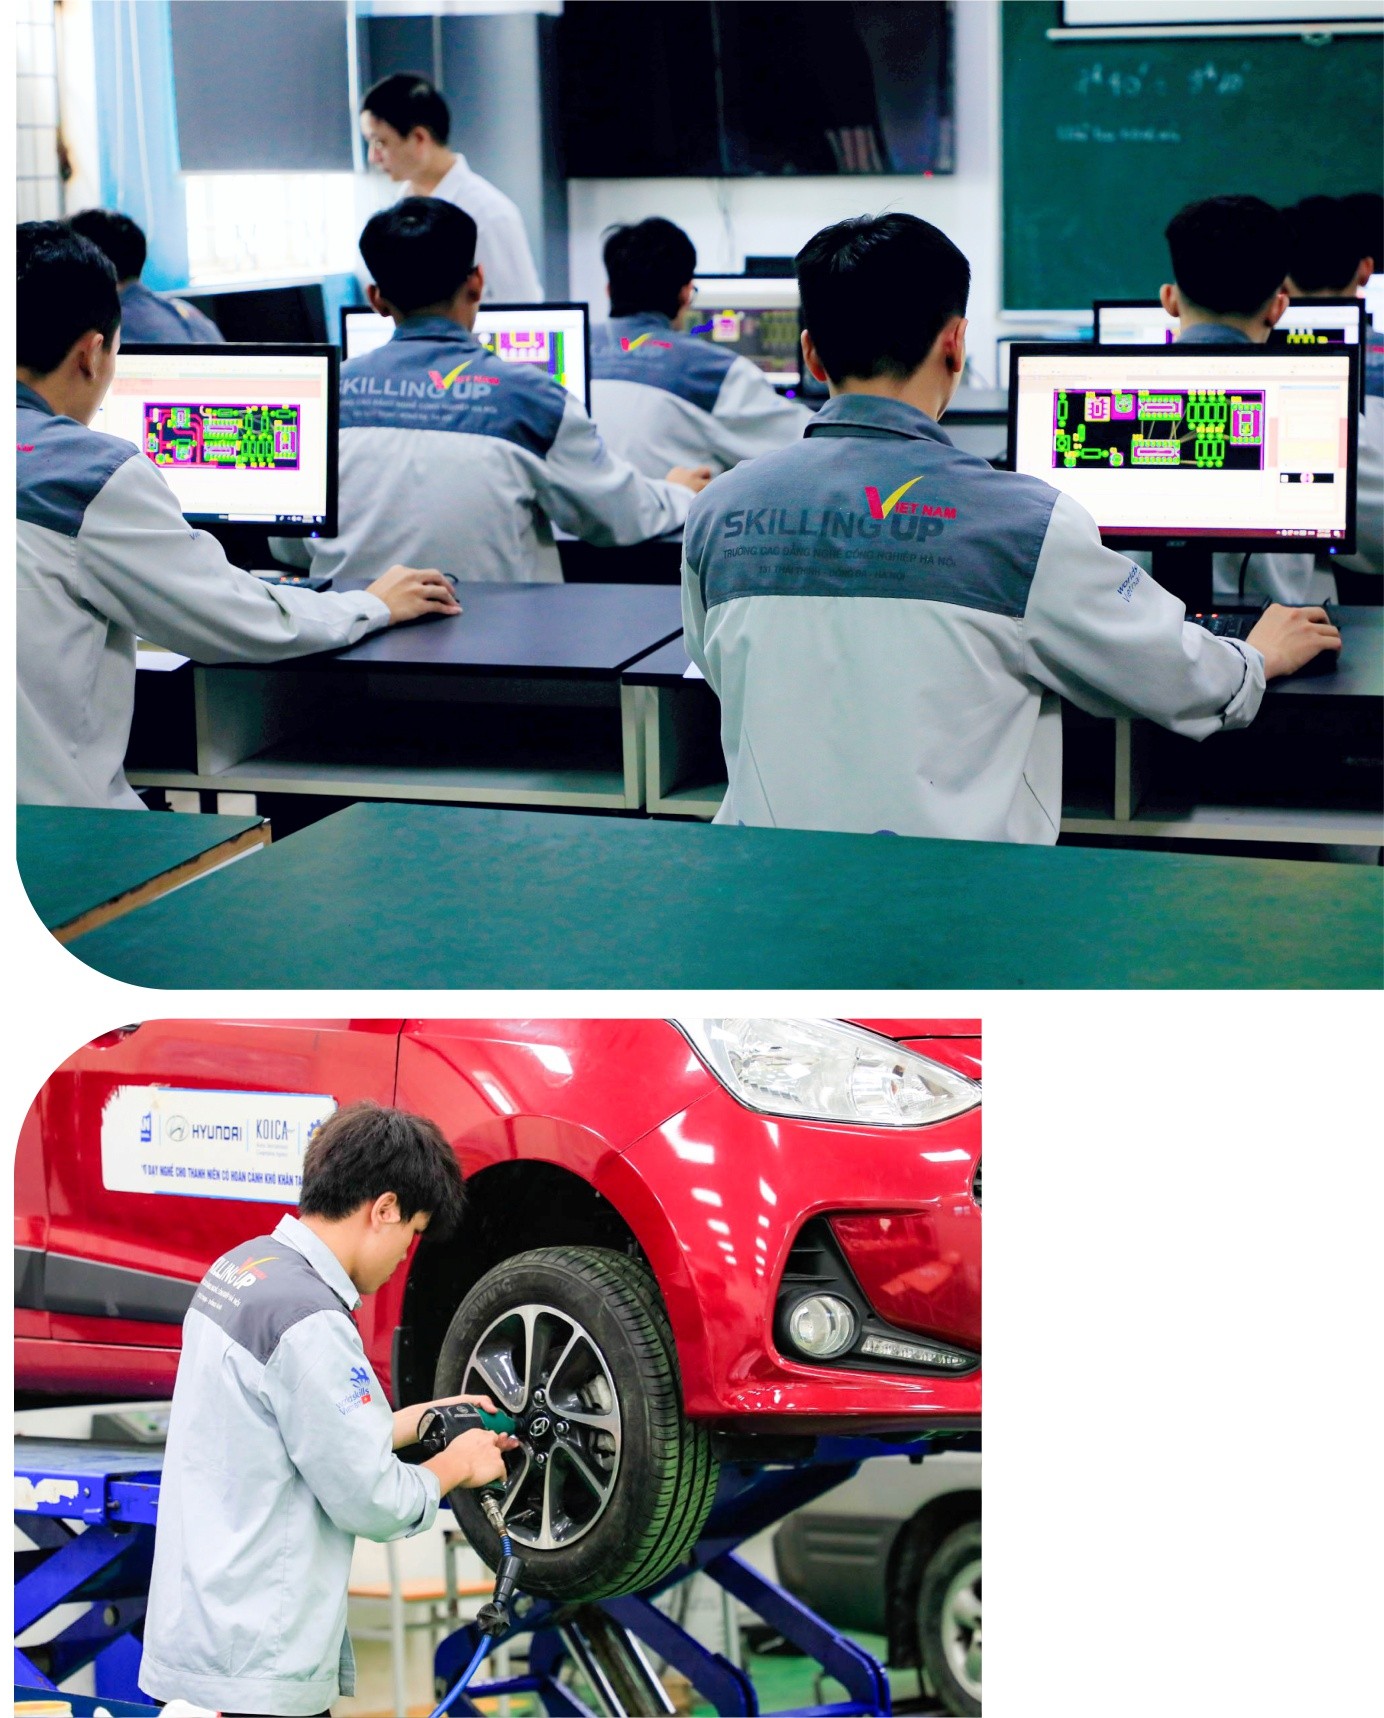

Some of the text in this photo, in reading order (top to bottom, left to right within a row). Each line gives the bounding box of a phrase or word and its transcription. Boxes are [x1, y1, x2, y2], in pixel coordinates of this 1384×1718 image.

[452, 382, 492, 400] UP
[922, 504, 957, 520] NAM
[724, 508, 944, 543] SKILLING UP
[192, 1118, 289, 1142] HYUNDAI KOICA
[176, 1167, 186, 1178] CHO
[188, 1167, 205, 1179] THANH
[207, 1167, 221, 1181] NIÊN
[232, 1270, 257, 1290] UP
